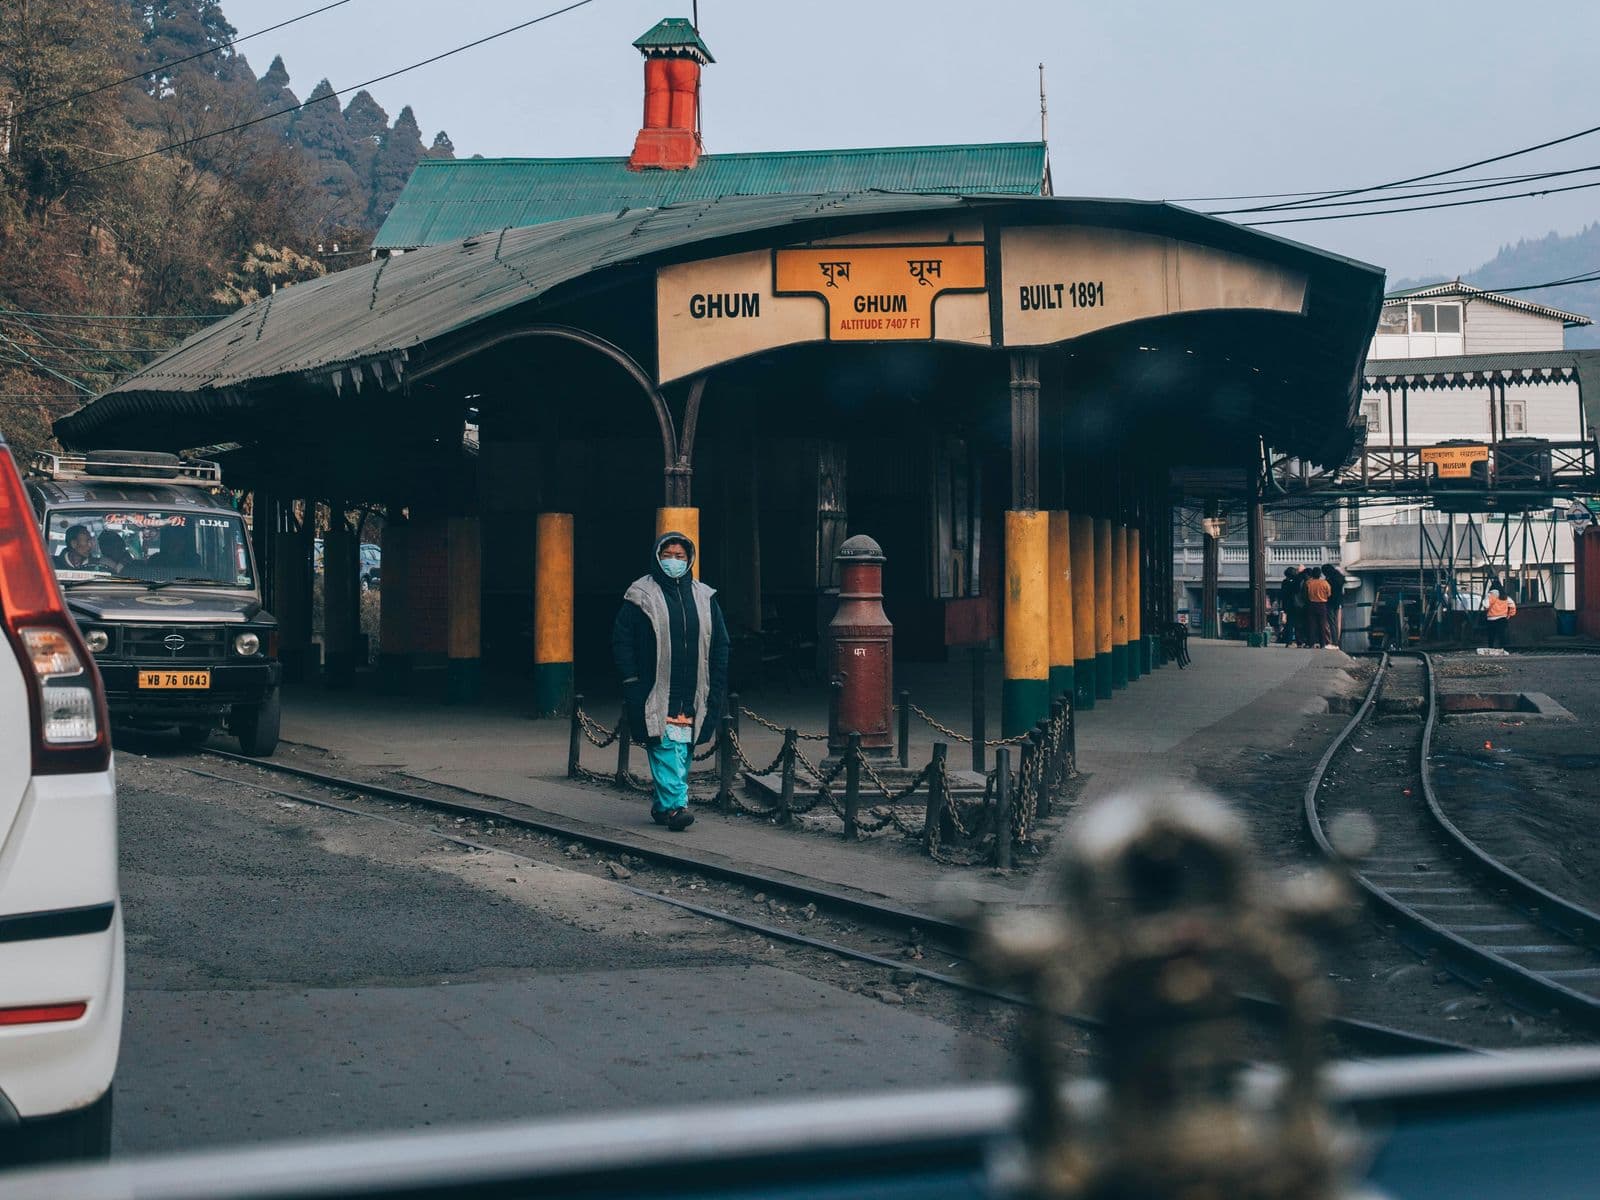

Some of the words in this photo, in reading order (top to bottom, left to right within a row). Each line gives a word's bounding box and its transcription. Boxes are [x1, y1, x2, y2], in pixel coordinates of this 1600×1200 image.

[818, 261, 851, 288] ঘুম
[907, 259, 943, 287] घूम
[689, 293, 760, 319] GHUM
[853, 295, 907, 312] GHUM
[1020, 284, 1064, 311] BUILT
[1069, 281, 1104, 308] 1891
[840, 319, 882, 330] ALTITUDE
[886, 318, 907, 329] 7407
[910, 318, 920, 329] FT
[147, 674, 160, 686] WB
[165, 674, 177, 686] 76
[182, 674, 207, 686] 0643
